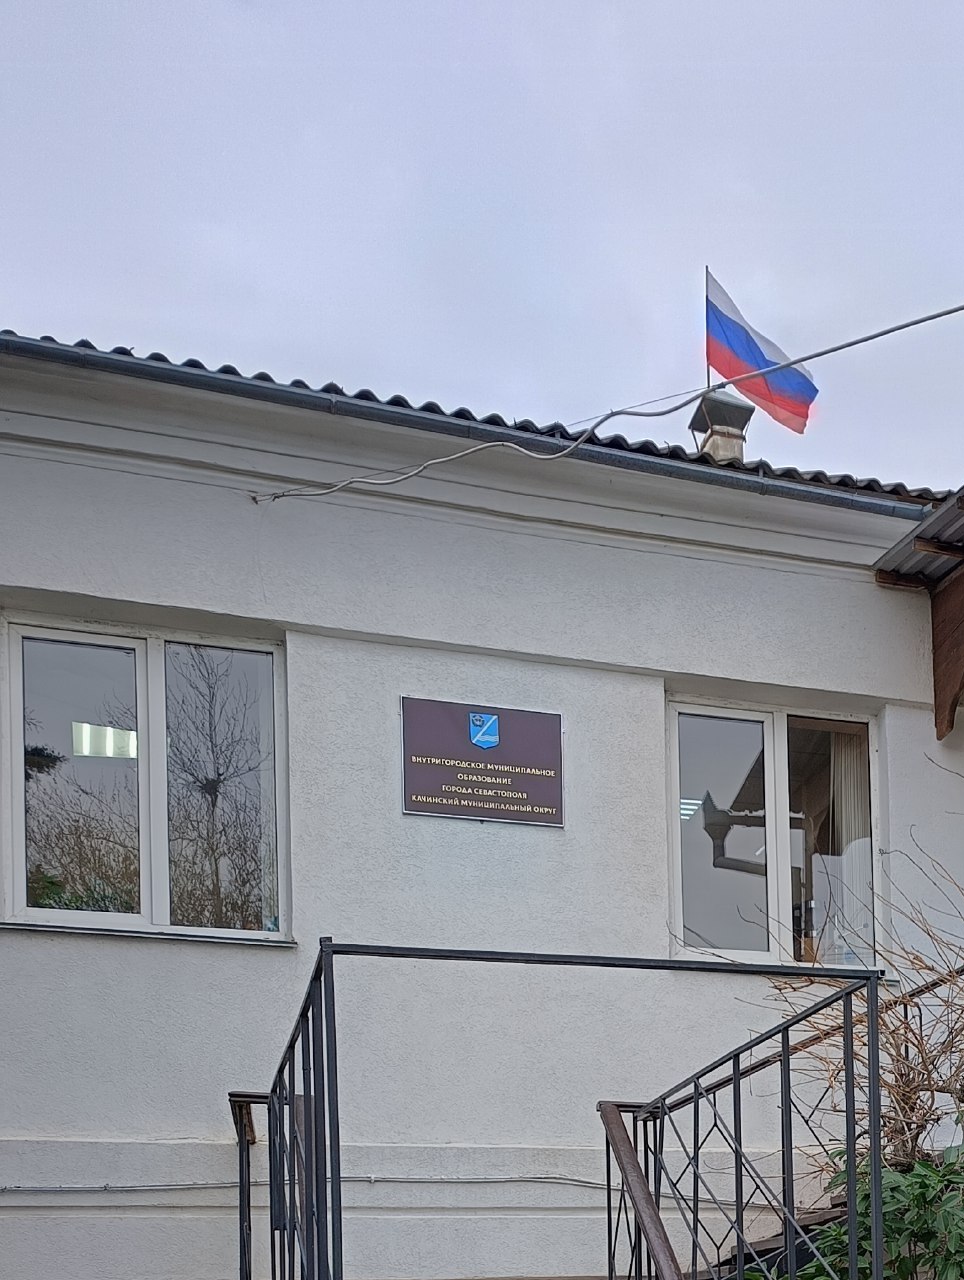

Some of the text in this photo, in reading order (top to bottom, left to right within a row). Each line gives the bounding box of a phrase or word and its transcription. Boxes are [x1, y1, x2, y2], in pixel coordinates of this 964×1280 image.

[411, 755, 556, 777] ВНУТРИГОРОДСКОЕ МУНИЦИПАЛЬНОЕ
[457, 773, 512, 785] ОБРАЗОВАНИЕ
[442, 784, 528, 799] ГОРОДА СЕВАСТОПОЛЯ
[411, 794, 557, 815] КАЧИНСКИЙ МУНИЦИПАЛЬНЫЙ ОКРУГ
